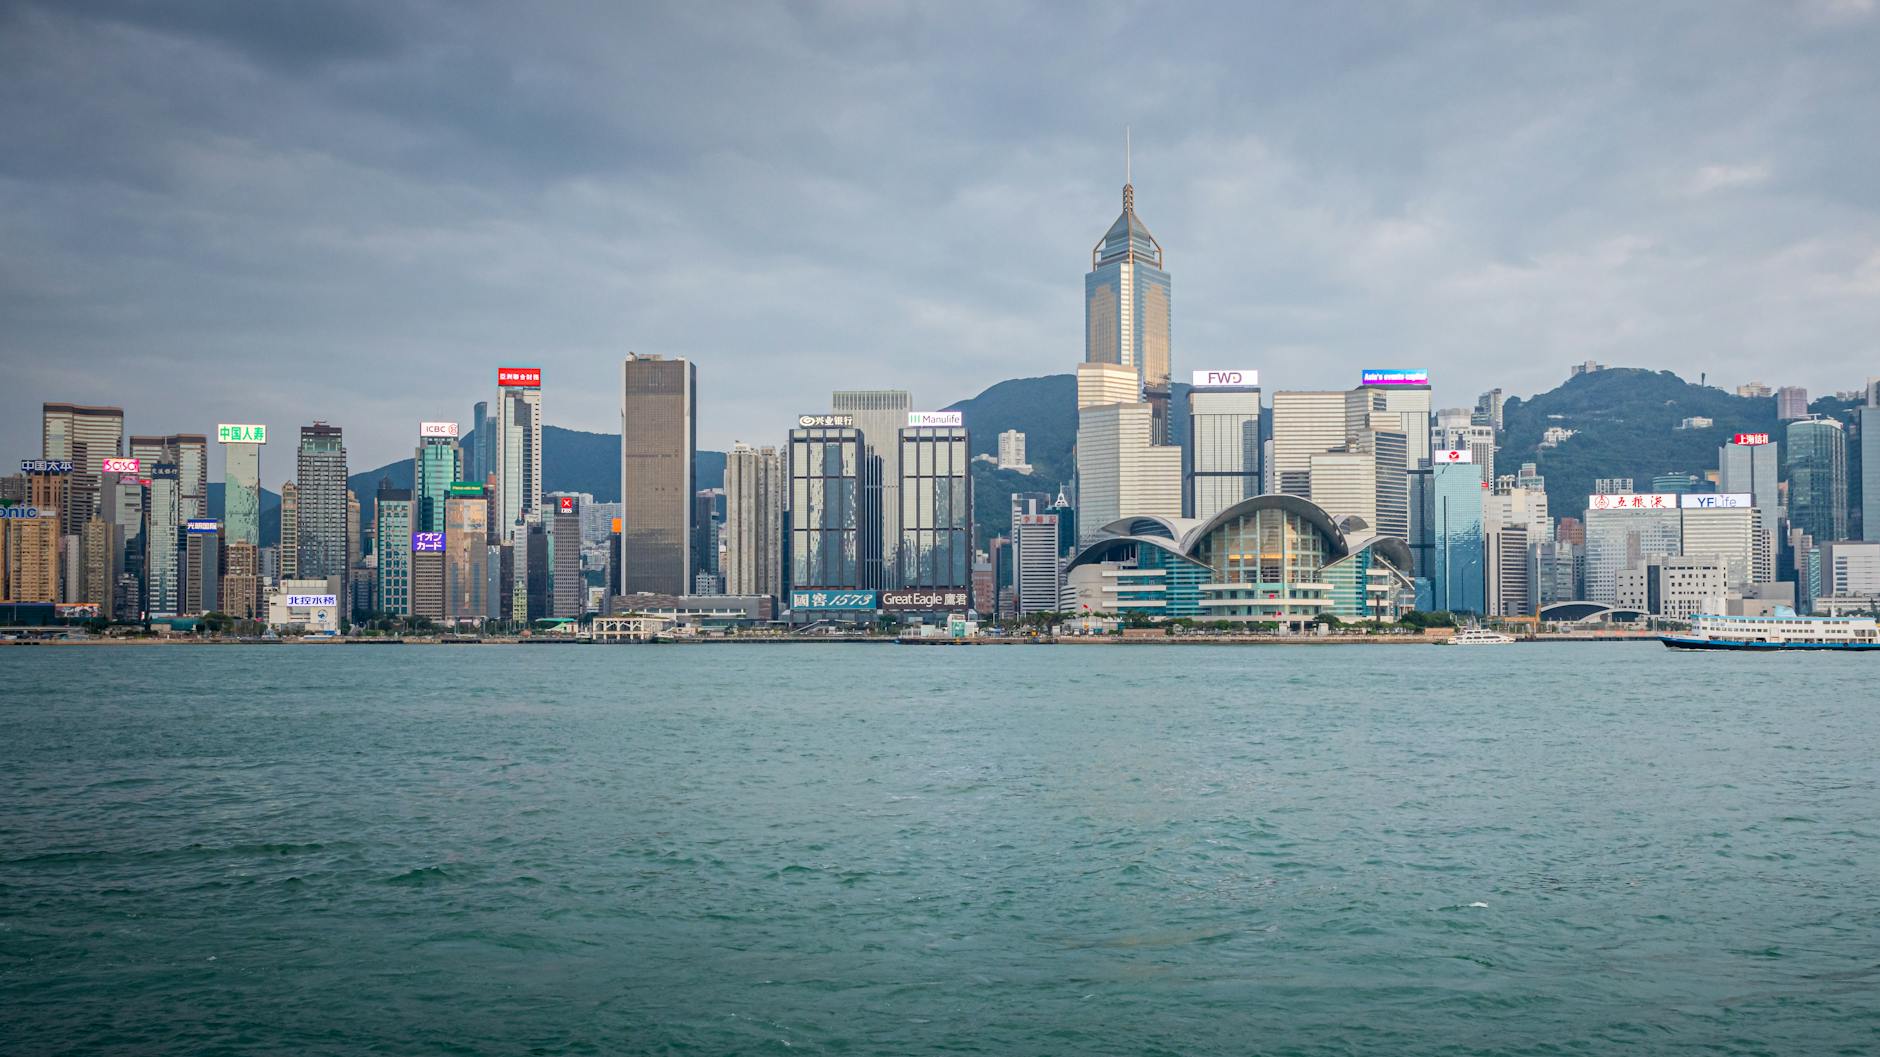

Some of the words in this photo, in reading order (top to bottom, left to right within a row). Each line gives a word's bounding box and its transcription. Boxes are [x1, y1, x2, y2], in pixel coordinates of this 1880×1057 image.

[1208, 372, 1242, 384] FWD
[814, 415, 852, 426] 兴业银行
[922, 414, 960, 424] Manulife
[220, 426, 264, 441] 中国人寿
[425, 425, 446, 433] ICBC
[21, 460, 73, 472] 中国太平
[416, 533, 442, 542] イオン
[416, 542, 442, 551] カード
[288, 596, 335, 606] 北控水務
[882, 593, 913, 605] Great
[913, 593, 943, 608] Eagle
